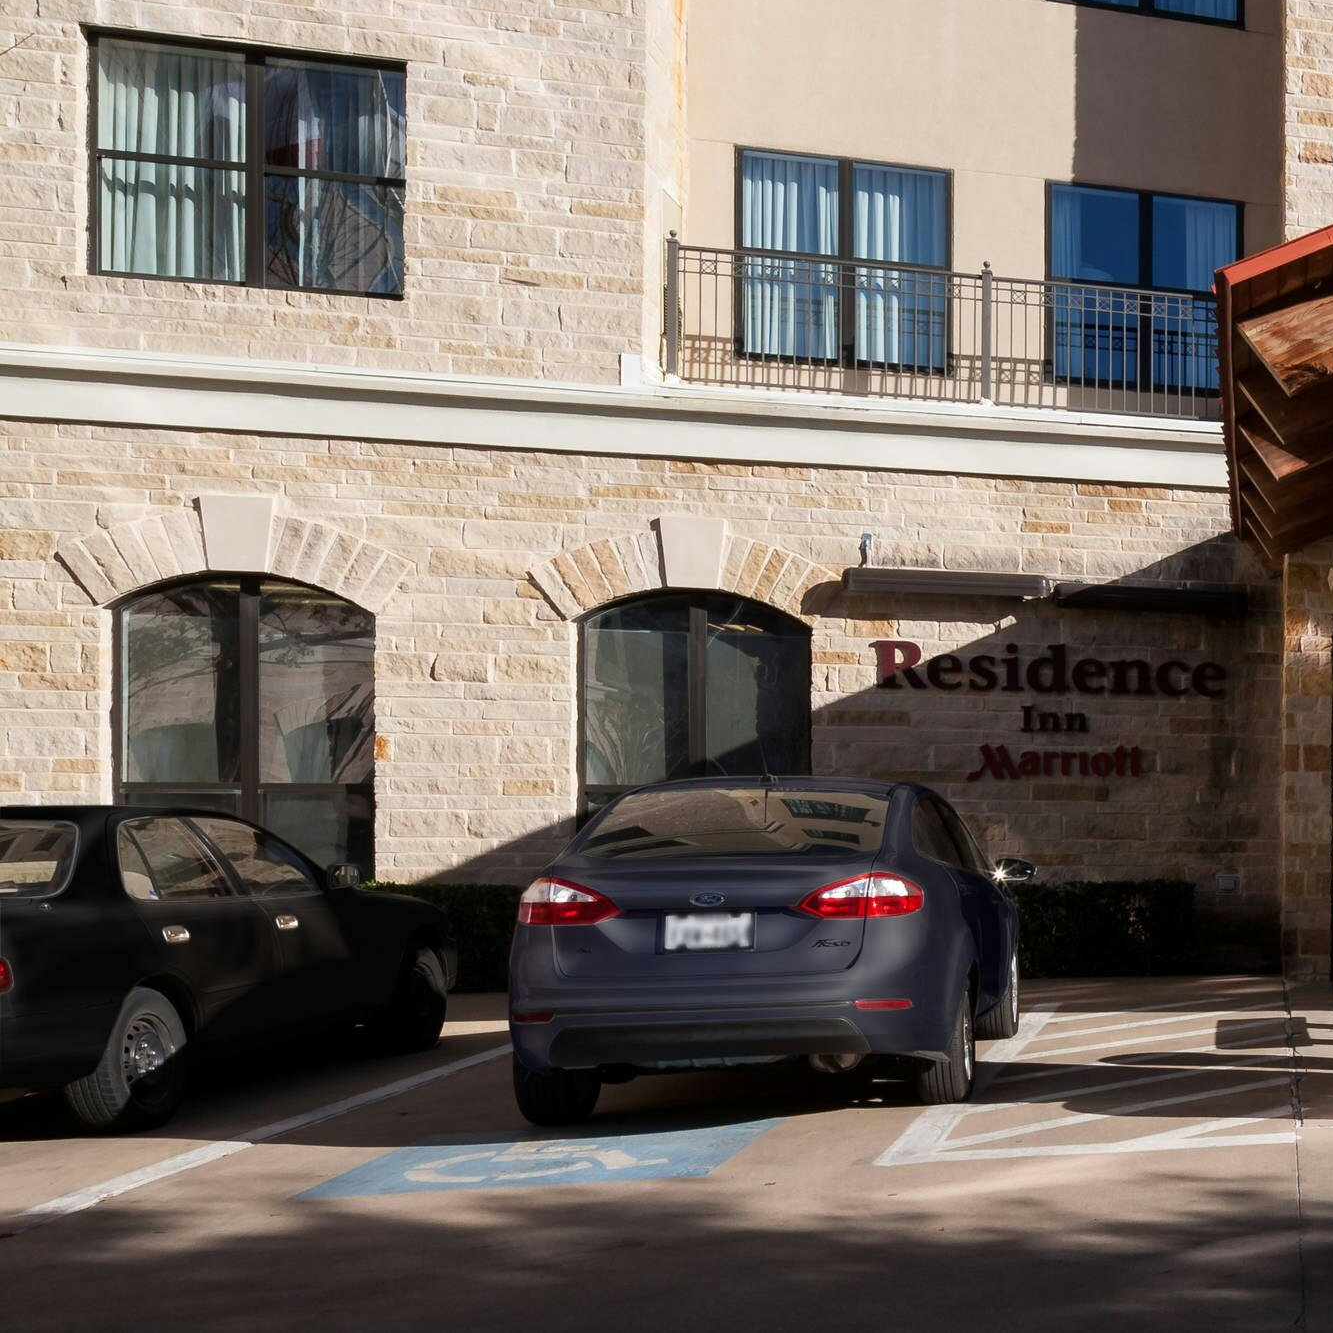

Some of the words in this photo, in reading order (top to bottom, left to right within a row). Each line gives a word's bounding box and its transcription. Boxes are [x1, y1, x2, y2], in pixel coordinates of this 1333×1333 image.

[873, 640, 1227, 697] Residence
[1020, 705, 1090, 734] Inn
[967, 744, 1144, 783] Marriott
